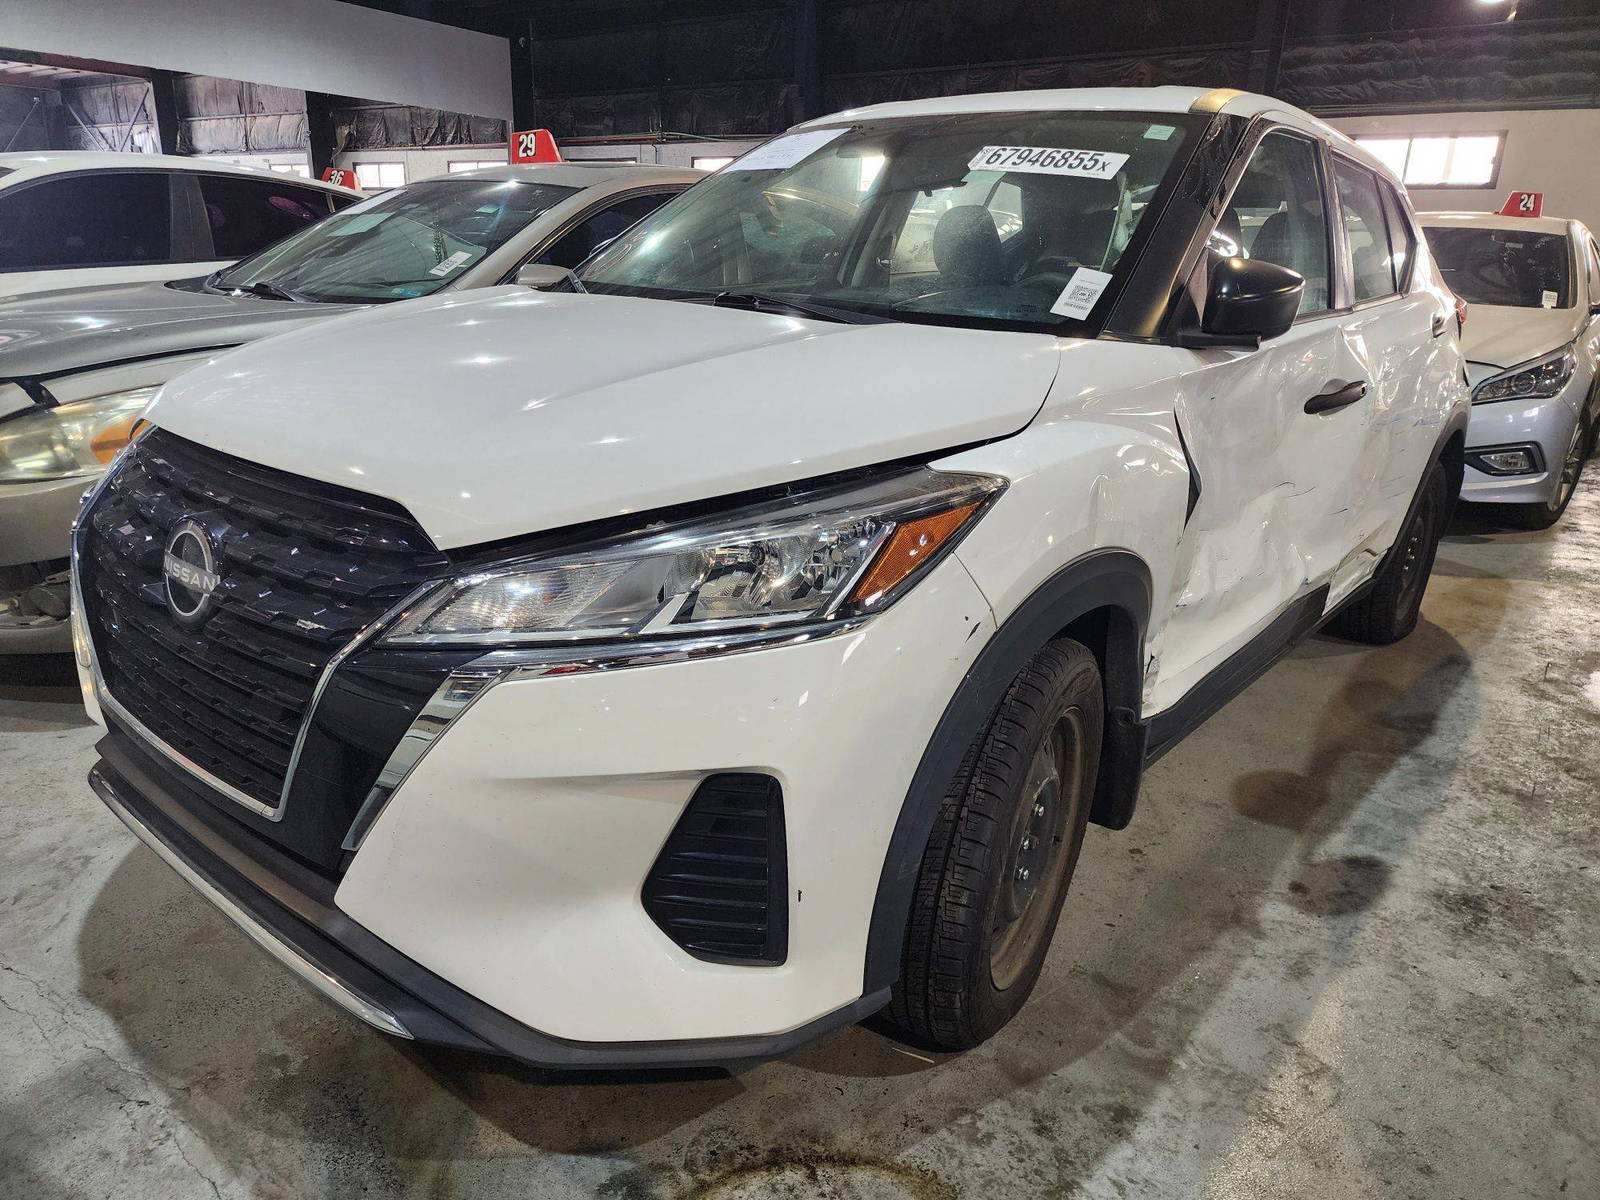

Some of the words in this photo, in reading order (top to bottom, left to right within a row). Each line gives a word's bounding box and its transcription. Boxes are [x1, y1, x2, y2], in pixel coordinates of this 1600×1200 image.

[519, 133, 536, 158] 29
[1520, 194, 1535, 211] 24
[164, 554, 216, 591] NISSAN
